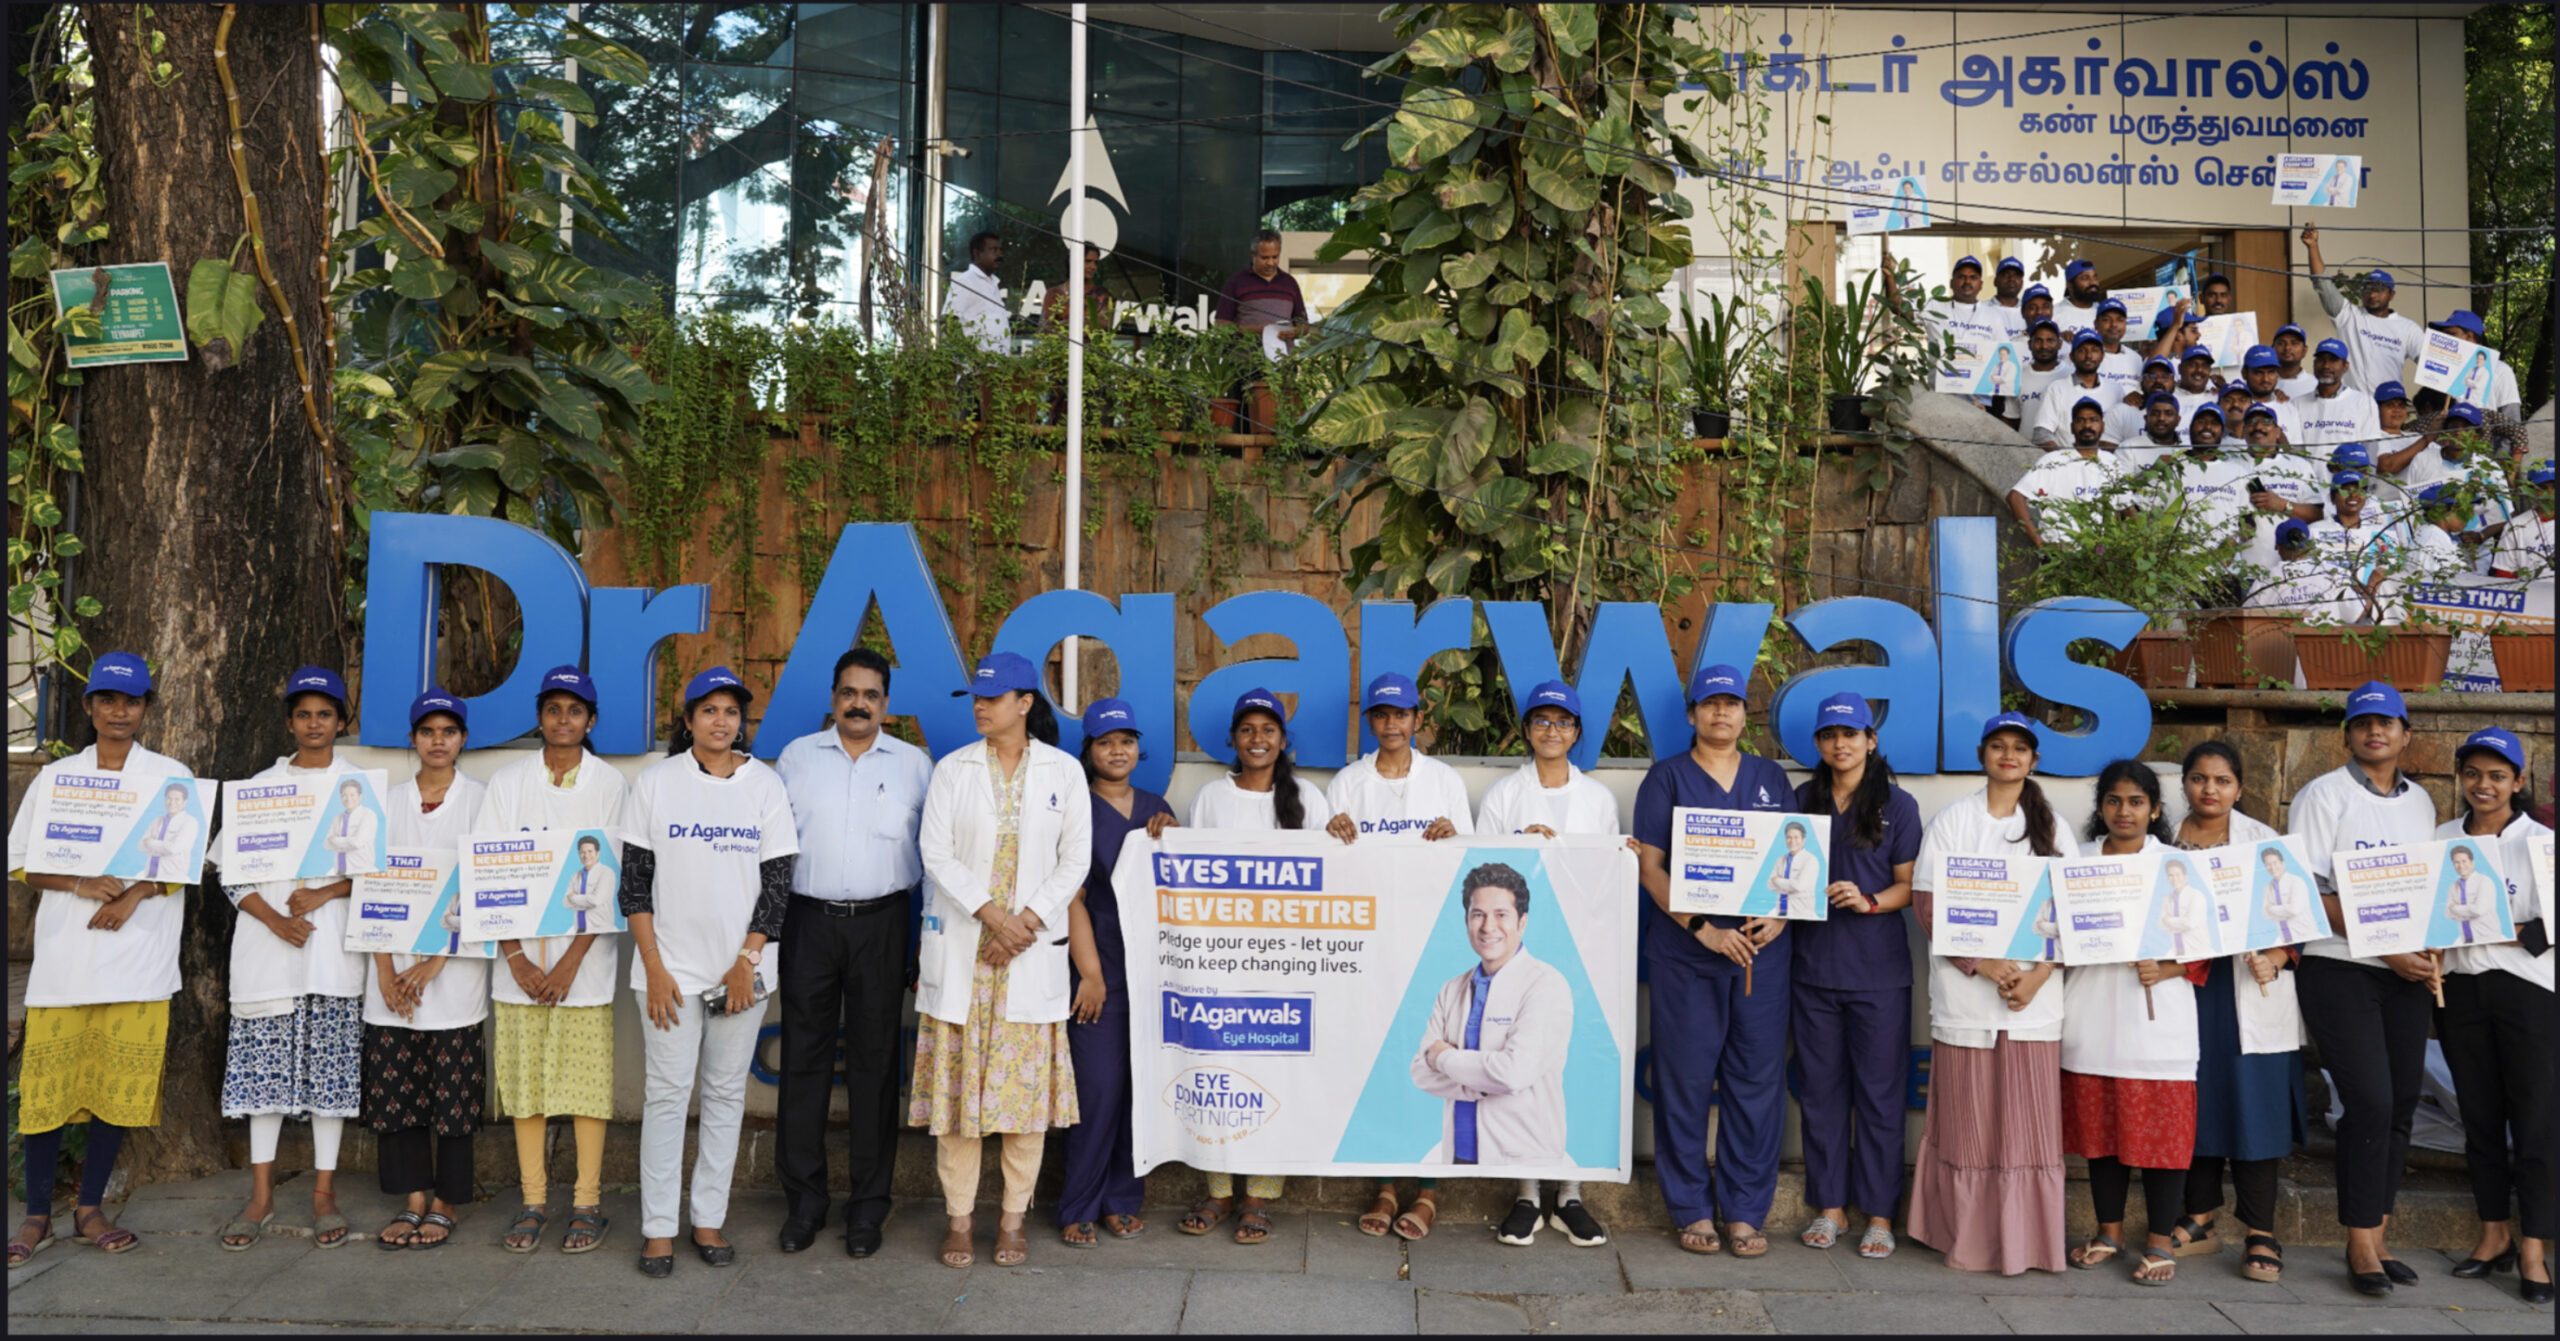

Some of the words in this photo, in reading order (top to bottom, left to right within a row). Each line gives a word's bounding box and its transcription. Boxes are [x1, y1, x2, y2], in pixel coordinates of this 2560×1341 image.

[1940, 37, 2369, 107] அகர்வால்ஸ்
[2019, 103, 2097, 133] கண்
[2110, 105, 2368, 145] மருத்துவமனை
[1941, 151, 2178, 186] எக்சல்லன்ஸ்
[1960, 321, 1993, 333] Agarwals
[2304, 420, 2313, 430] Dr
[2315, 419, 2355, 430] Agarwals
[2075, 486, 2086, 496] Dr
[2466, 590, 2522, 609] THAT
[359, 512, 709, 755] Dr
[754, 517, 2150, 797] Agarwals
[58, 776, 86, 786] EYES
[88, 778, 118, 788] THAT
[55, 788, 92, 800] NEVER
[239, 790, 265, 799] EYES
[266, 786, 295, 797] THAT
[1360, 820, 1375, 833] Dr
[1378, 817, 1437, 835] Agarw
[1696, 816, 1728, 825] LEGACY
[50, 824, 60, 833] Dr
[61, 824, 100, 836] Agarwals
[669, 824, 688, 838] Dr
[690, 824, 760, 842] Agarwals
[1687, 826, 1718, 835] VISION
[1720, 828, 1742, 836] THAT
[476, 843, 503, 853] EYES
[505, 842, 532, 852] THAT
[395, 858, 420, 866] THAT
[476, 854, 511, 865] NEVER
[514, 852, 551, 863] RETIRE
[1957, 860, 1990, 868] LEGACY
[2349, 860, 2376, 869] EYES
[2378, 855, 2405, 865] THAT
[1158, 856, 1228, 884] EYES
[1236, 860, 1317, 886] THAT
[1697, 867, 1731, 876] Agarwals
[1948, 869, 1980, 877] VISION
[1981, 871, 2006, 879] THAT
[2066, 867, 2092, 877] EYES
[2094, 866, 2121, 874] THAT
[2352, 870, 2387, 880] NEVER
[488, 890, 524, 902] Agarwals
[374, 905, 406, 914] Agarwals
[1160, 894, 1255, 922] NEVER
[1262, 898, 1370, 925] RETIRE
[1960, 911, 1995, 920] Agarwals
[1158, 930, 1201, 951] Pledge
[1206, 936, 1243, 953] your
[1248, 936, 1286, 953] eyes
[1301, 936, 1321, 952] let
[1326, 939, 1364, 954] your
[1158, 952, 1194, 970] vision
[1199, 955, 1237, 974] keep
[1241, 956, 1316, 975] changing
[1320, 958, 1363, 974] lives.
[1206, 986, 1218, 995] by
[1170, 997, 1188, 1021] Dr
[1189, 1002, 1302, 1030] Agarwals
[1223, 1032, 1245, 1046] Eye
[1248, 1032, 1299, 1047] Hospital
[1195, 1073, 1230, 1090] EYE
[1176, 1084, 1263, 1109] DONATION
